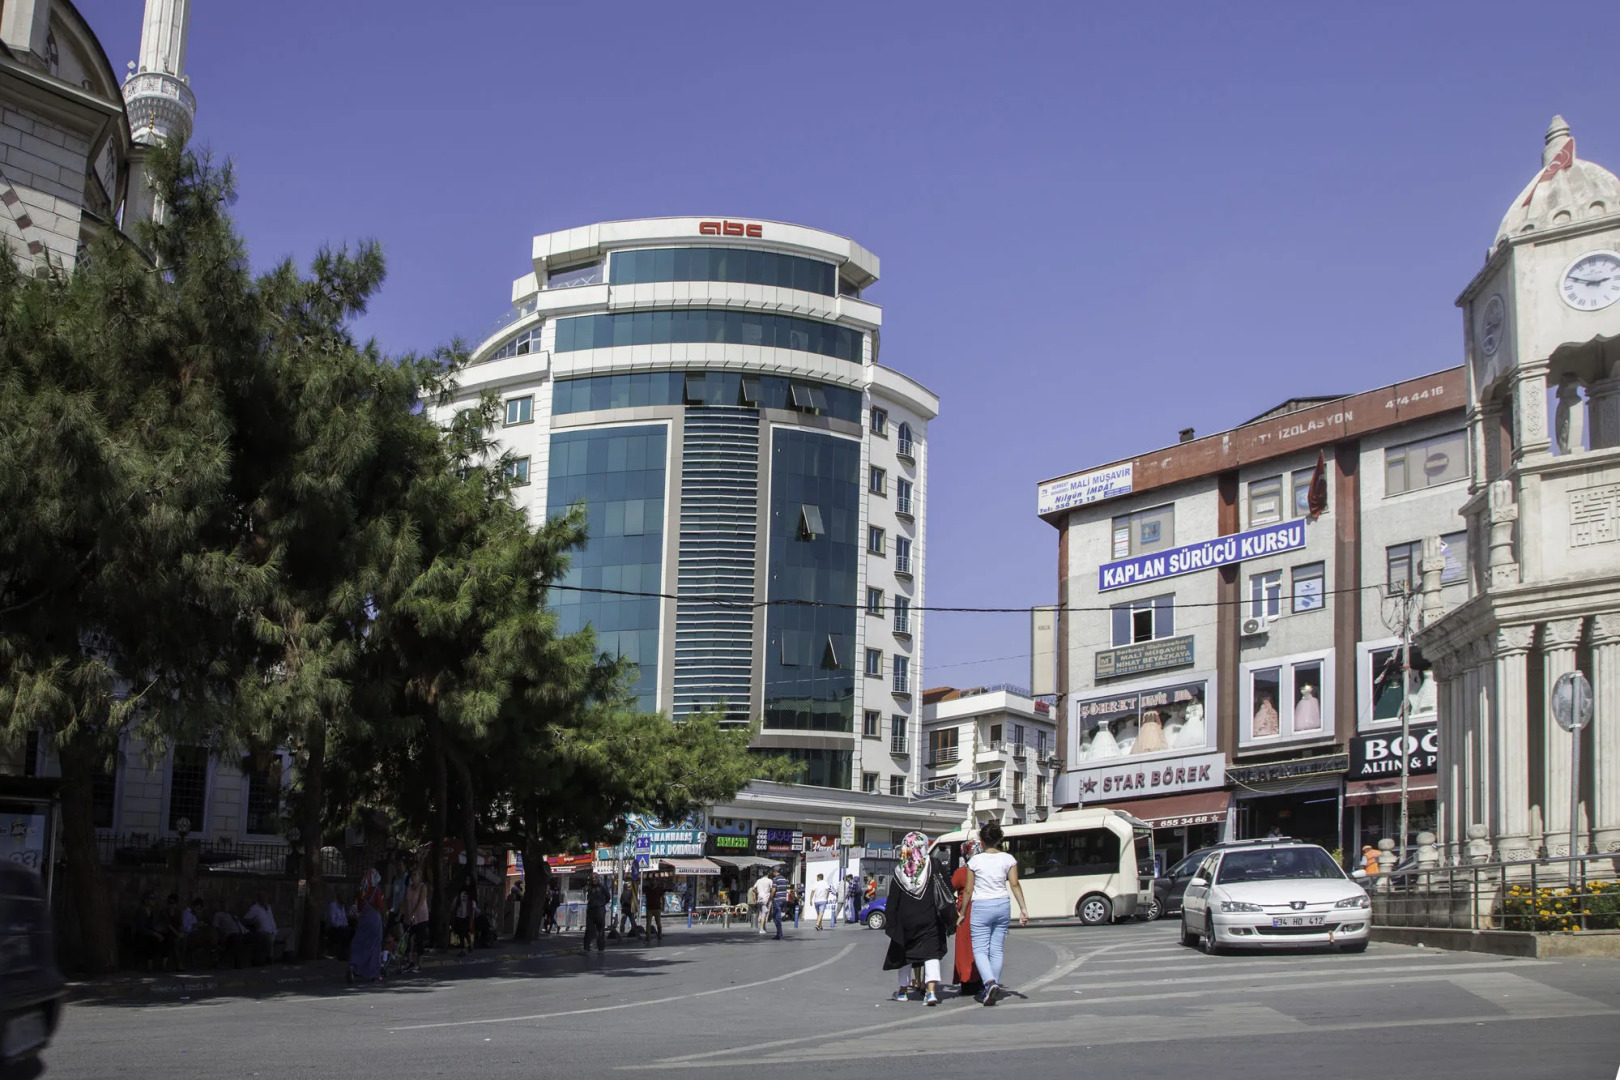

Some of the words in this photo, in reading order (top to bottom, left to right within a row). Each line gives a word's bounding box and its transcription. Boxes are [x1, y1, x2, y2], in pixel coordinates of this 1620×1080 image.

[699, 220, 762, 238] abc
[1070, 476, 1090, 490] MALİ
[1092, 467, 1131, 484] MÜŞAVİR
[1054, 492, 1082, 504] Nilgün
[1103, 558, 1165, 587] KAPLAN
[1169, 539, 1236, 572] SÜRÜCÜ
[1241, 526, 1300, 557] KURSU
[1080, 698, 1137, 718] ŞÖHRET
[1410, 757, 1421, 768] &
[1103, 771, 1145, 792] STAR
[1150, 764, 1211, 787] BÖREK
